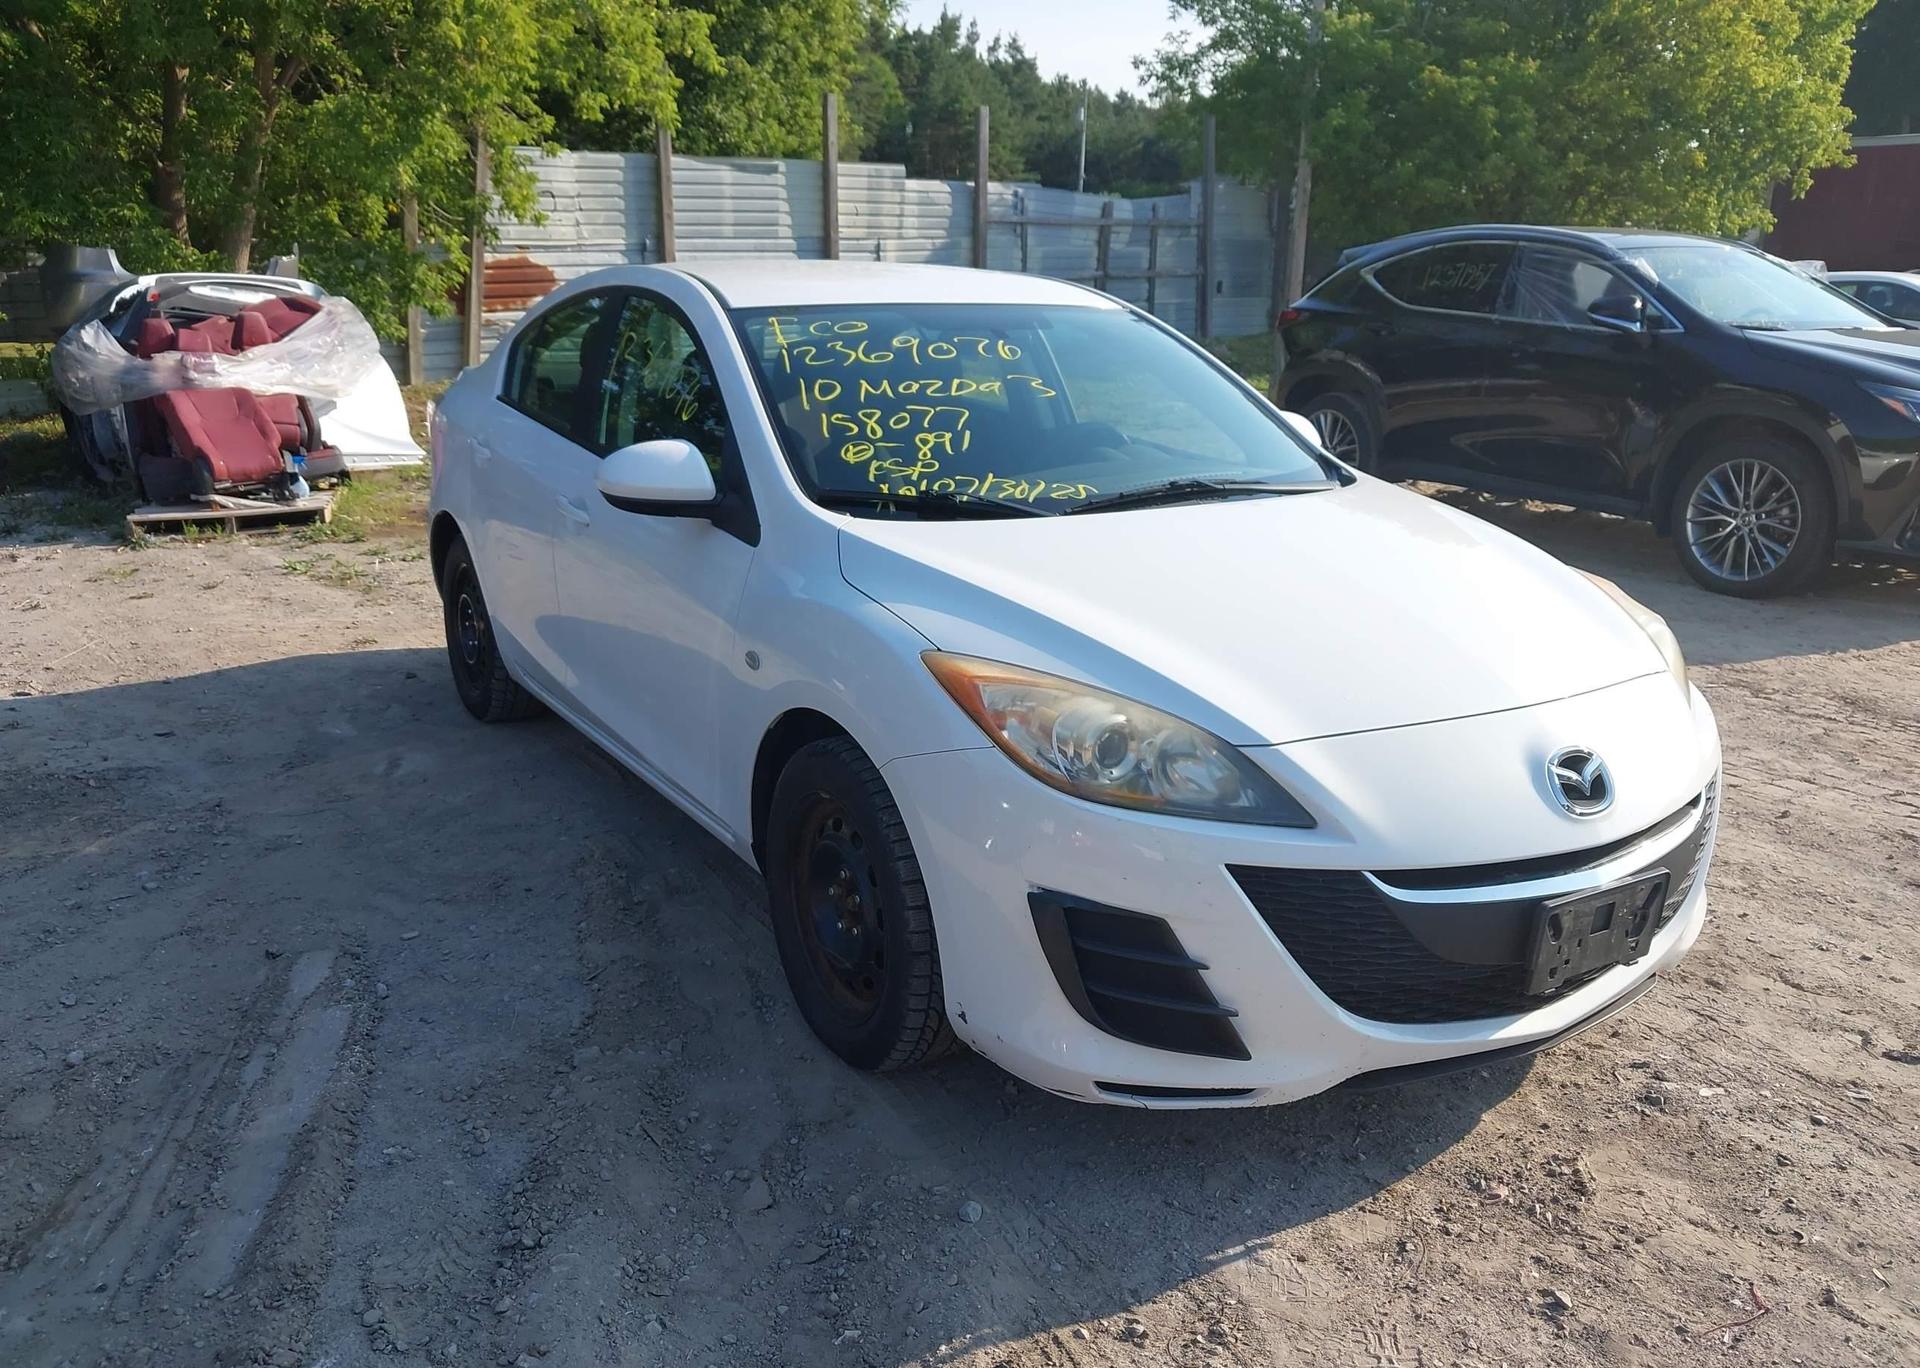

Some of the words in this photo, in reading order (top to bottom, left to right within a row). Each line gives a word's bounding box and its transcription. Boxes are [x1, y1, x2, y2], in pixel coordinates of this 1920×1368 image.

[781, 335, 1022, 374] 12369076
[800, 377, 842, 410] 10
[1006, 374, 1056, 398] 3
[820, 405, 970, 439] 158077
